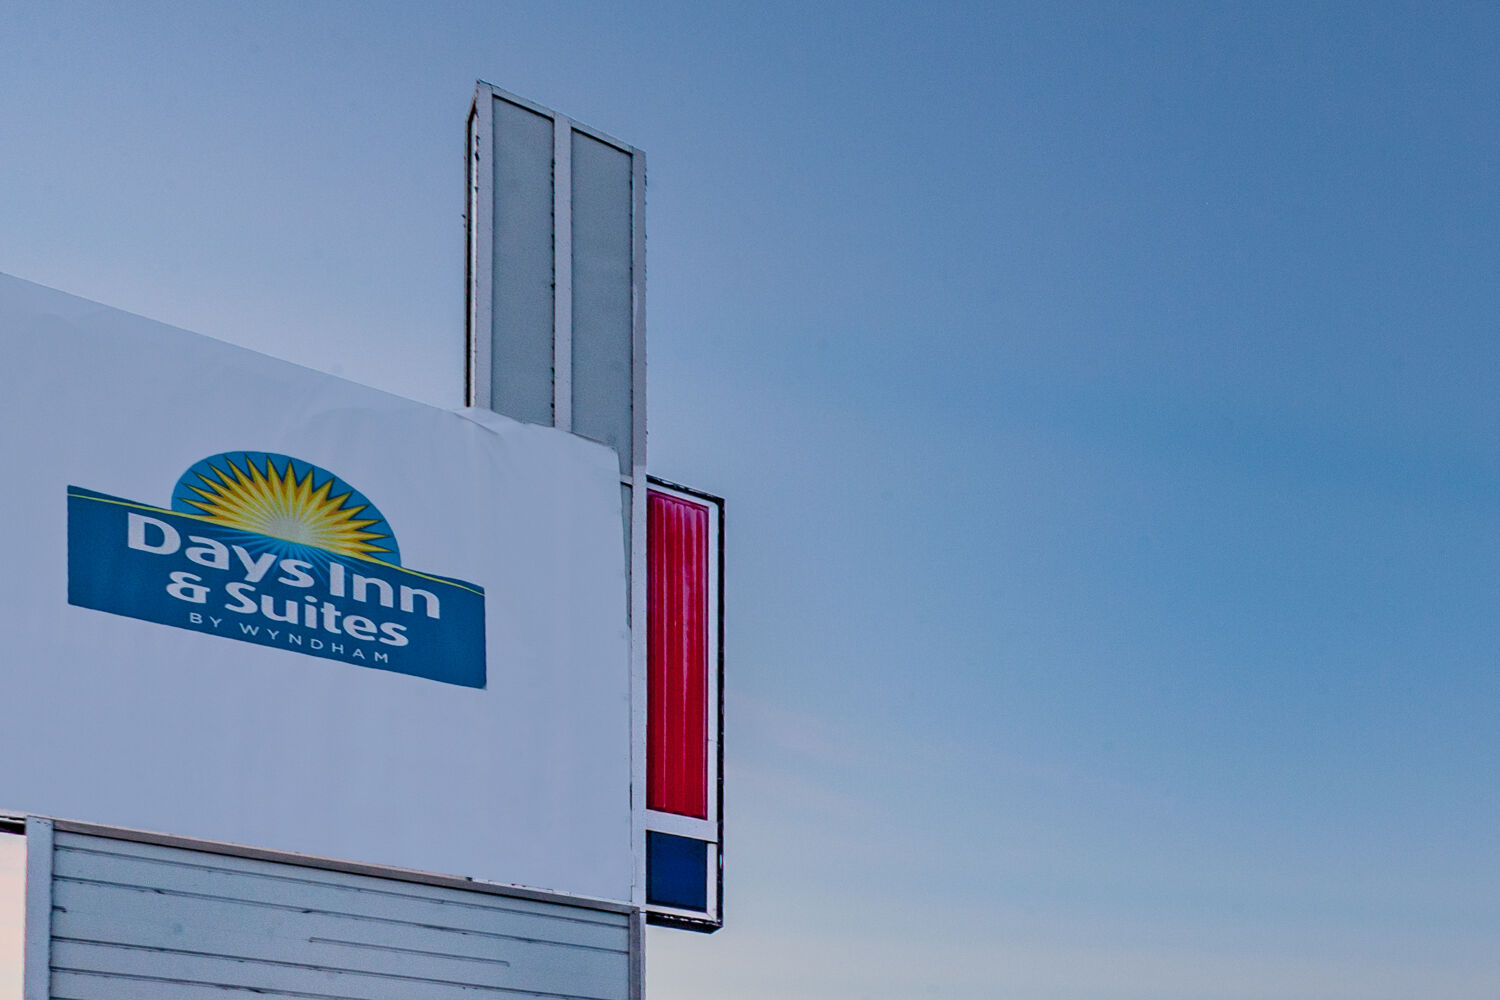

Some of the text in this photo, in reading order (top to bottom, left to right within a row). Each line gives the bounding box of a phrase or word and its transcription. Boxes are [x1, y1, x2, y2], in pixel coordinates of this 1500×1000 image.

[127, 511, 440, 619] Days Inn
[166, 571, 409, 647] & Suites
[189, 611, 389, 664] BY WYNDHAM
